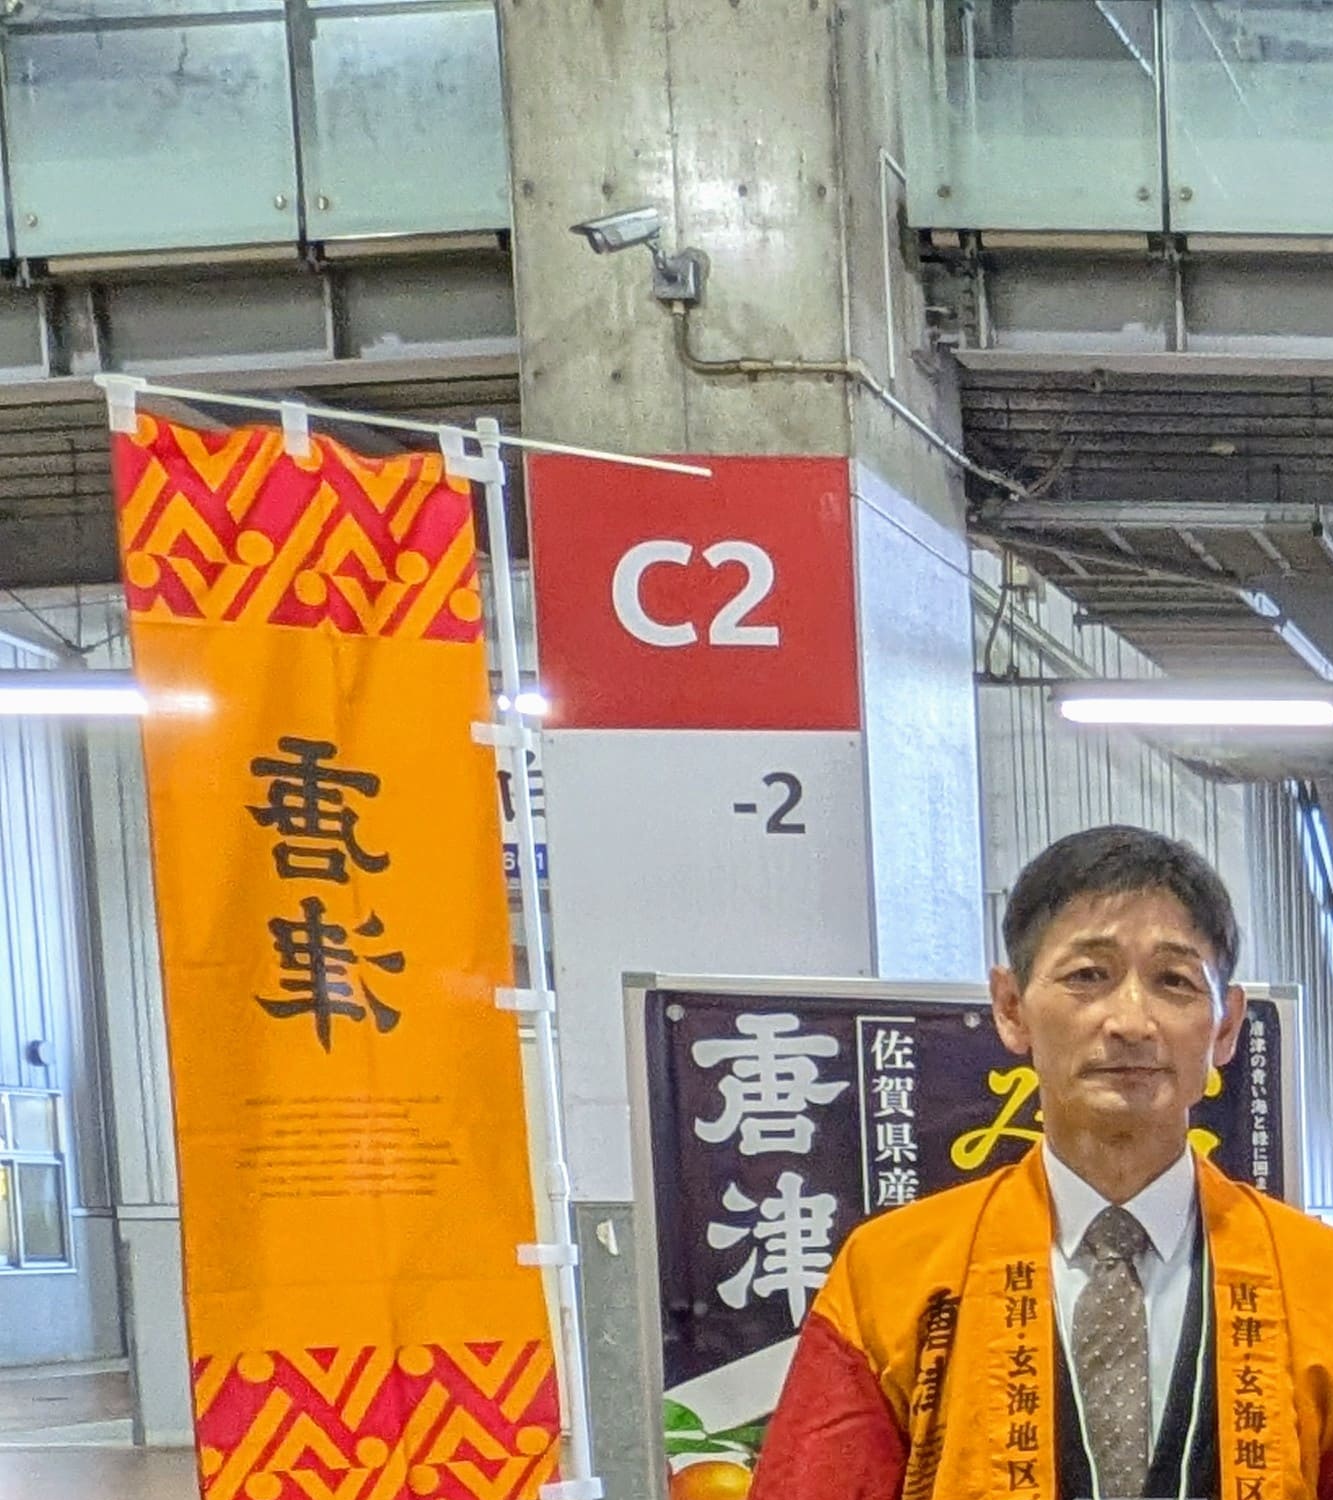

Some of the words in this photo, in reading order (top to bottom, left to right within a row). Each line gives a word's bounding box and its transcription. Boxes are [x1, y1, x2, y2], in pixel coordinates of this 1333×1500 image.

[611, 540, 780, 647] C2
[732, 771, 807, 836] -2
[691, 1012, 852, 1331] 唐津
[871, 1028, 921, 1208] 佐賀県産
